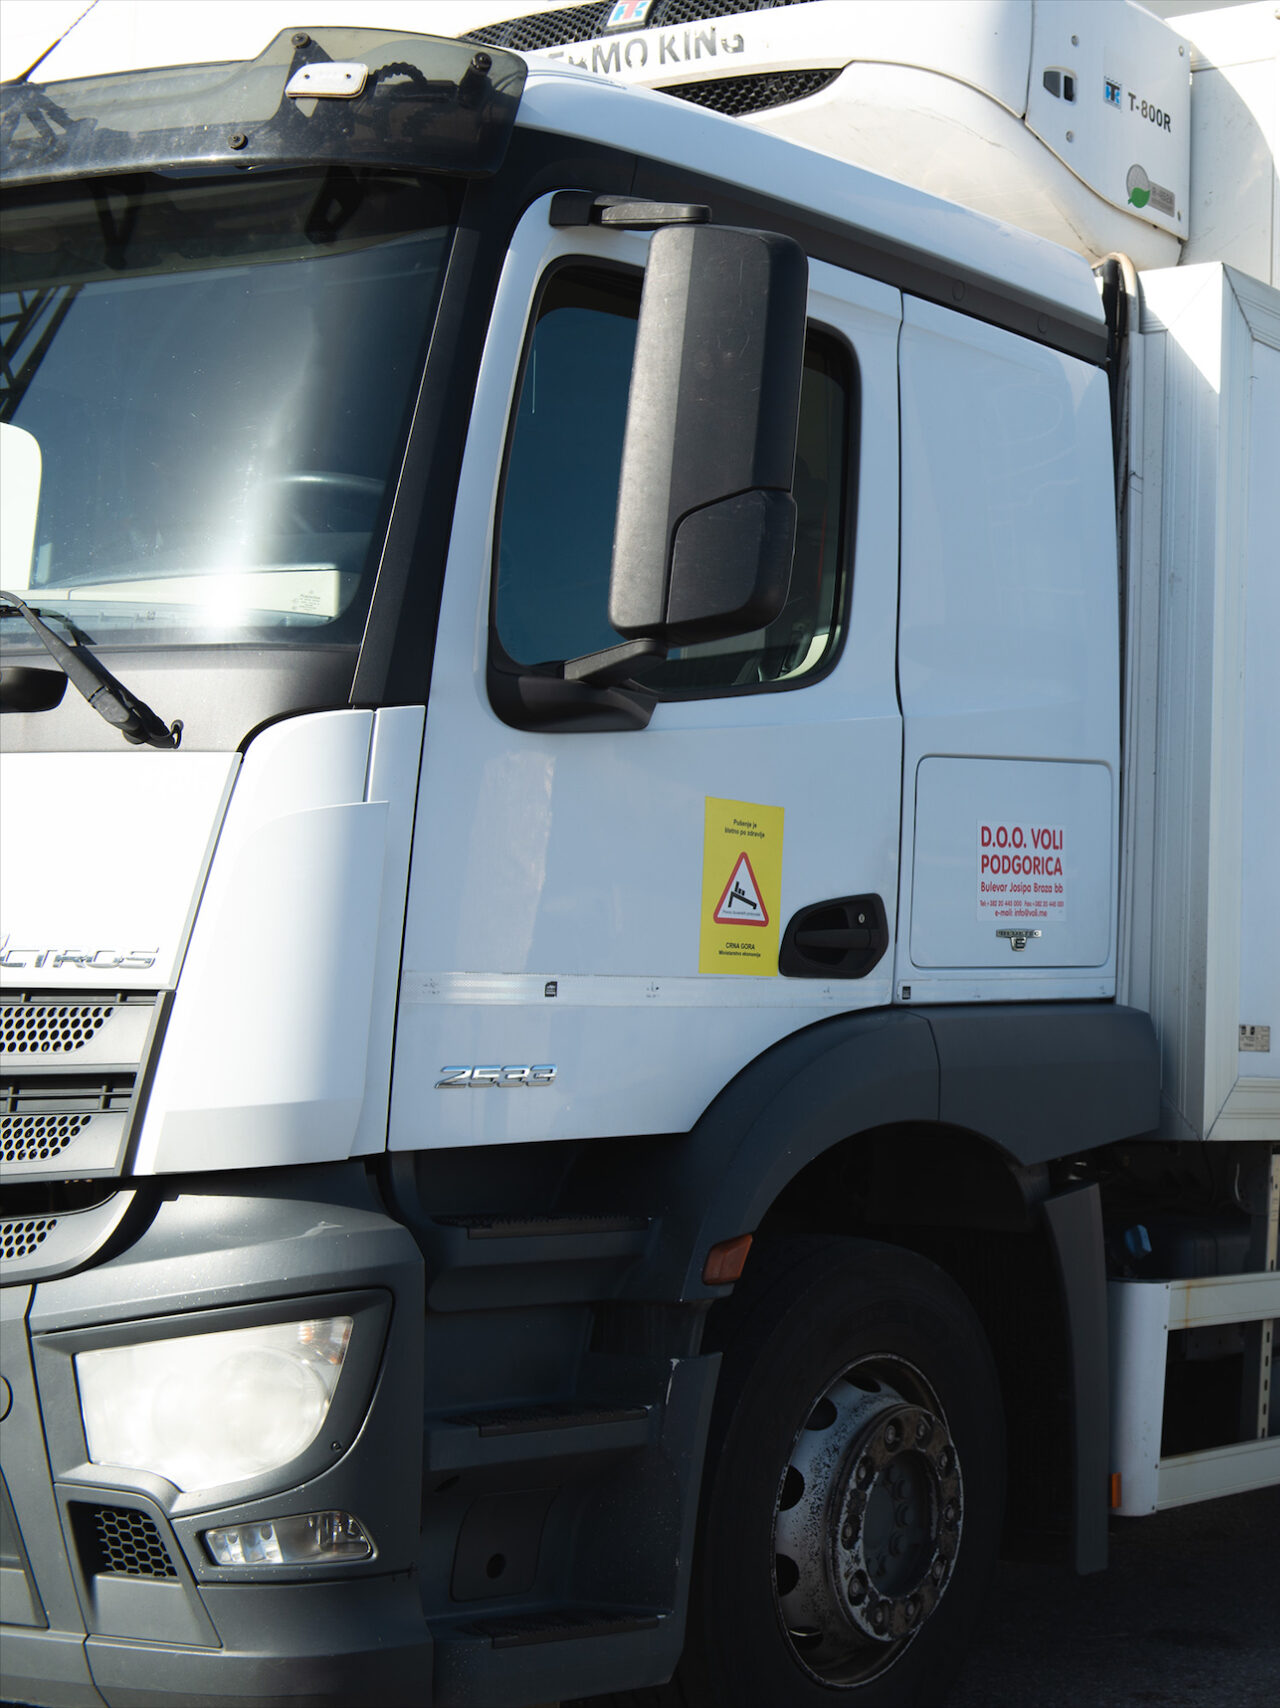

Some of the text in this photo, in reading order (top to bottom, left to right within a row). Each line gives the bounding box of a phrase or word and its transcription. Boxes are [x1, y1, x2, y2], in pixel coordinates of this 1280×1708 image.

[659, 26, 745, 66] KING
[1127, 92, 1172, 133] T-800R
[981, 825, 1063, 850] D.O.O. VOLI
[981, 854, 1063, 876] PODGORICA
[980, 881, 1008, 893] Bulevar
[1009, 881, 1031, 895] Josipa
[1054, 882, 1063, 893] bb
[434, 1063, 558, 1089] 2533
